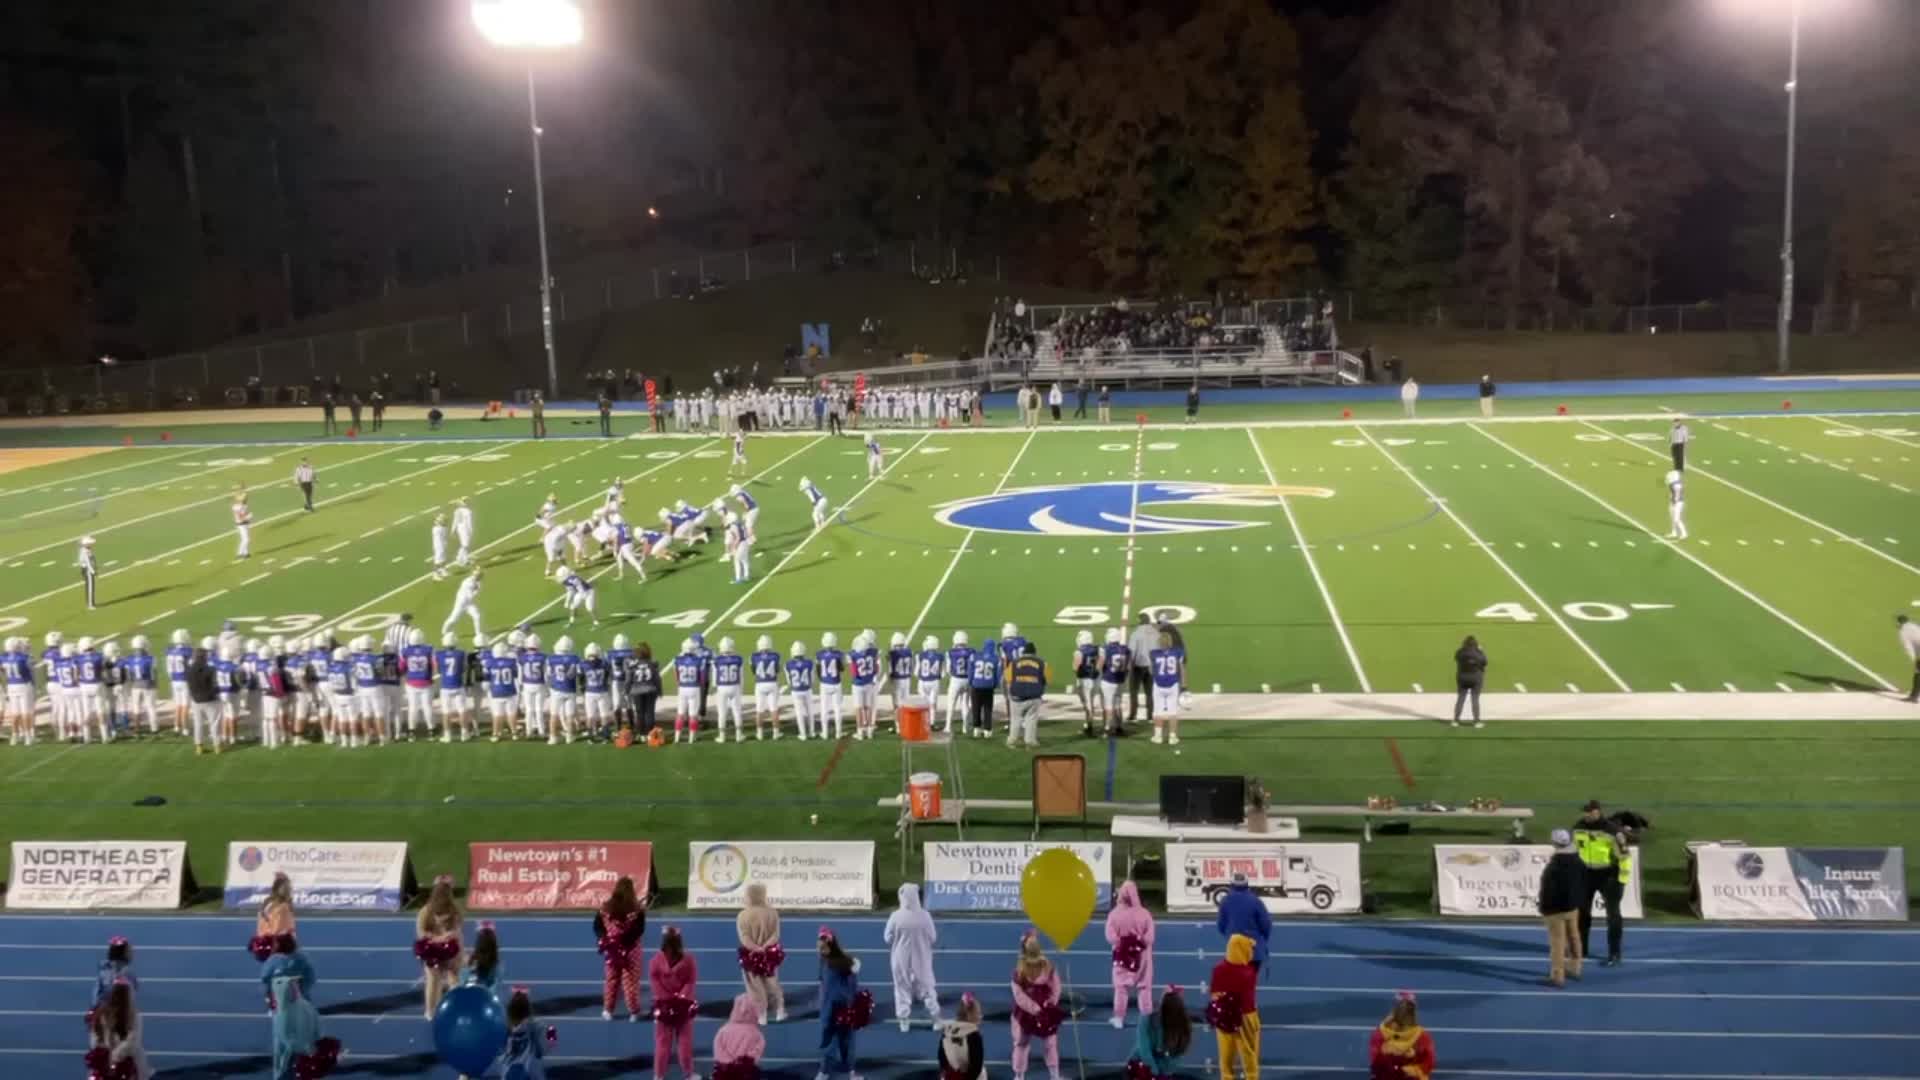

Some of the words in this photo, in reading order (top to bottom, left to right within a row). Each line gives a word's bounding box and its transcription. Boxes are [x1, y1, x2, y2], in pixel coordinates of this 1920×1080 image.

[444, 657, 456, 677] 7
[755, 660, 777, 679] 44
[974, 660, 995, 679] 26
[1154, 656, 1178, 676] 79
[791, 668, 810, 687] 24
[23, 848, 174, 866] NORTHEAST
[488, 847, 584, 864] Newtown's
[937, 844, 1018, 859] Newtown
[21, 867, 171, 886] GENERATOR
[477, 868, 513, 883] Real
[518, 868, 571, 883] Estate
[1203, 859, 1227, 879] ABC
[1823, 866, 1882, 882] Insure
